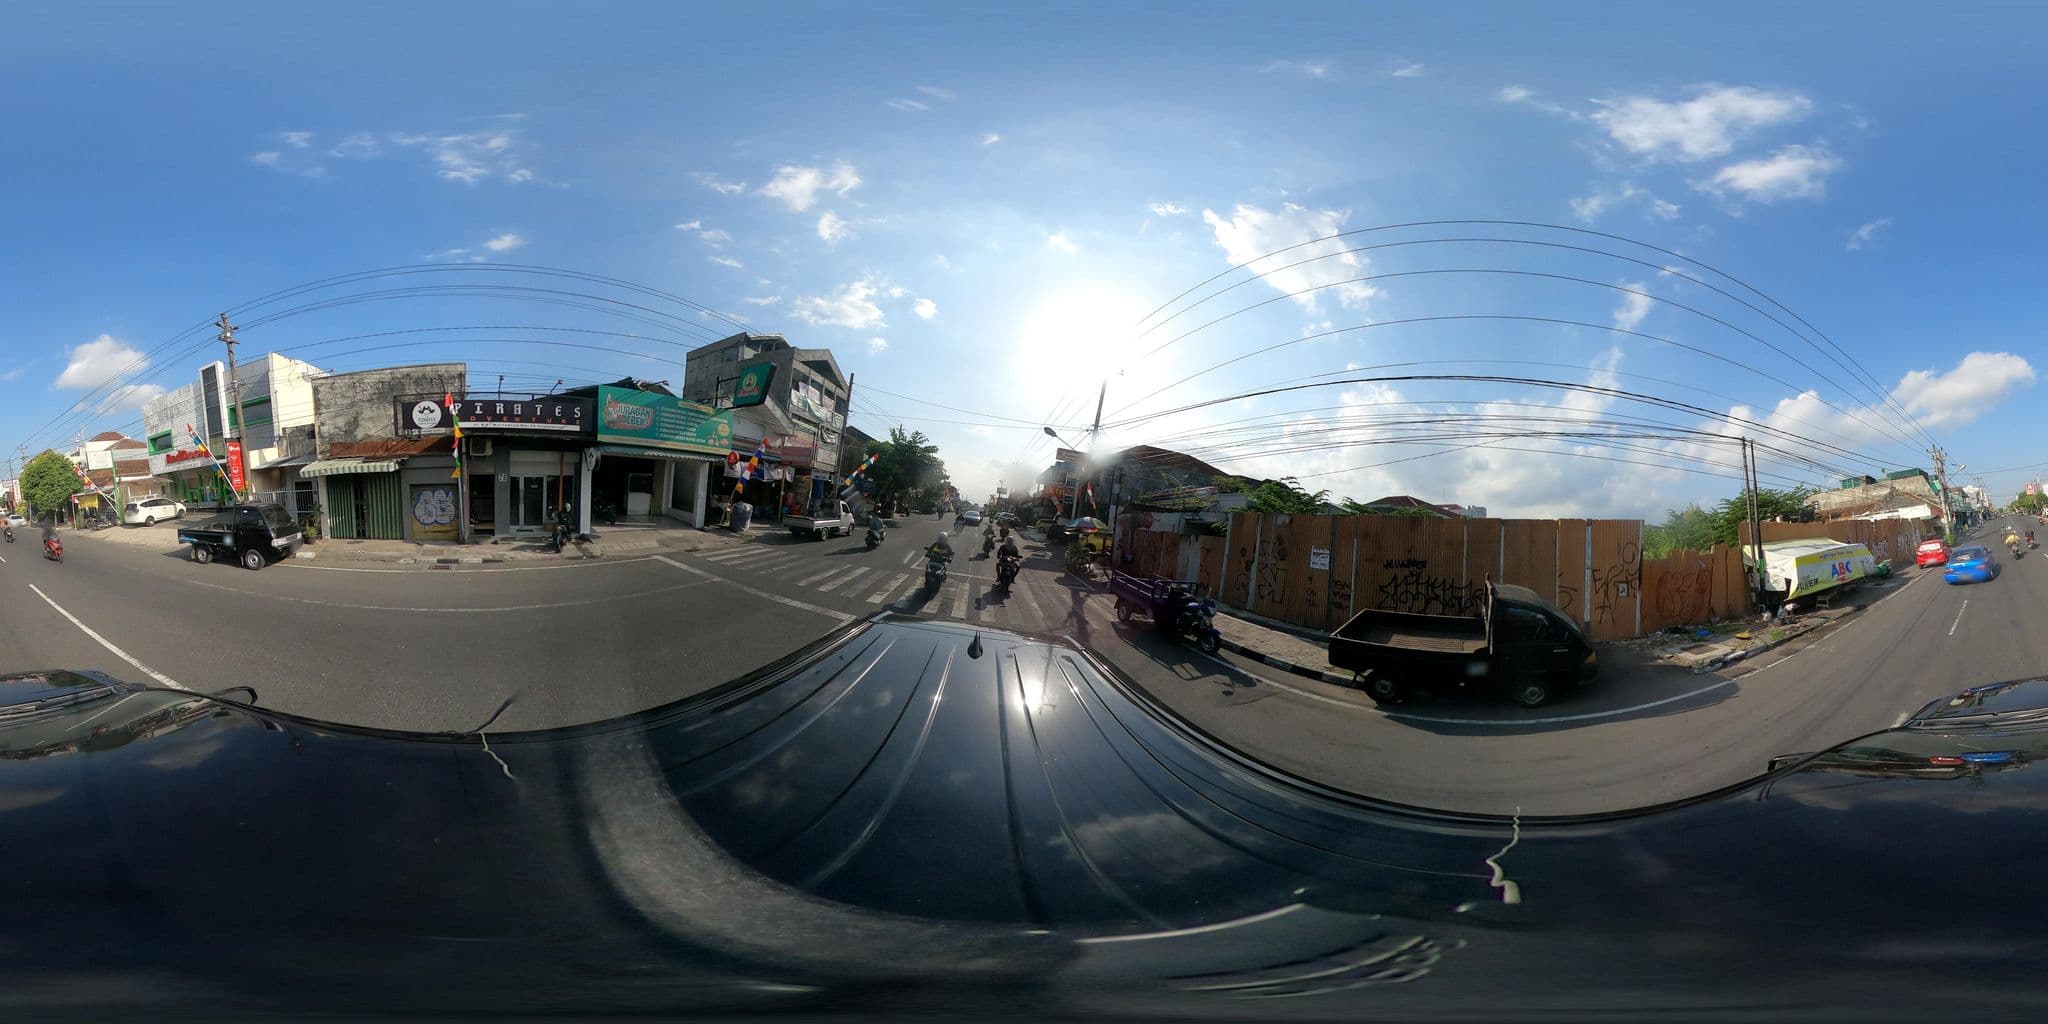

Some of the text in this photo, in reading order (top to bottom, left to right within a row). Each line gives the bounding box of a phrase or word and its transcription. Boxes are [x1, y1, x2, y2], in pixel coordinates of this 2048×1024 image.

[453, 402, 582, 418] PIRATES
[458, 414, 581, 425] DVENTURE
[1831, 560, 1853, 578] ABC
